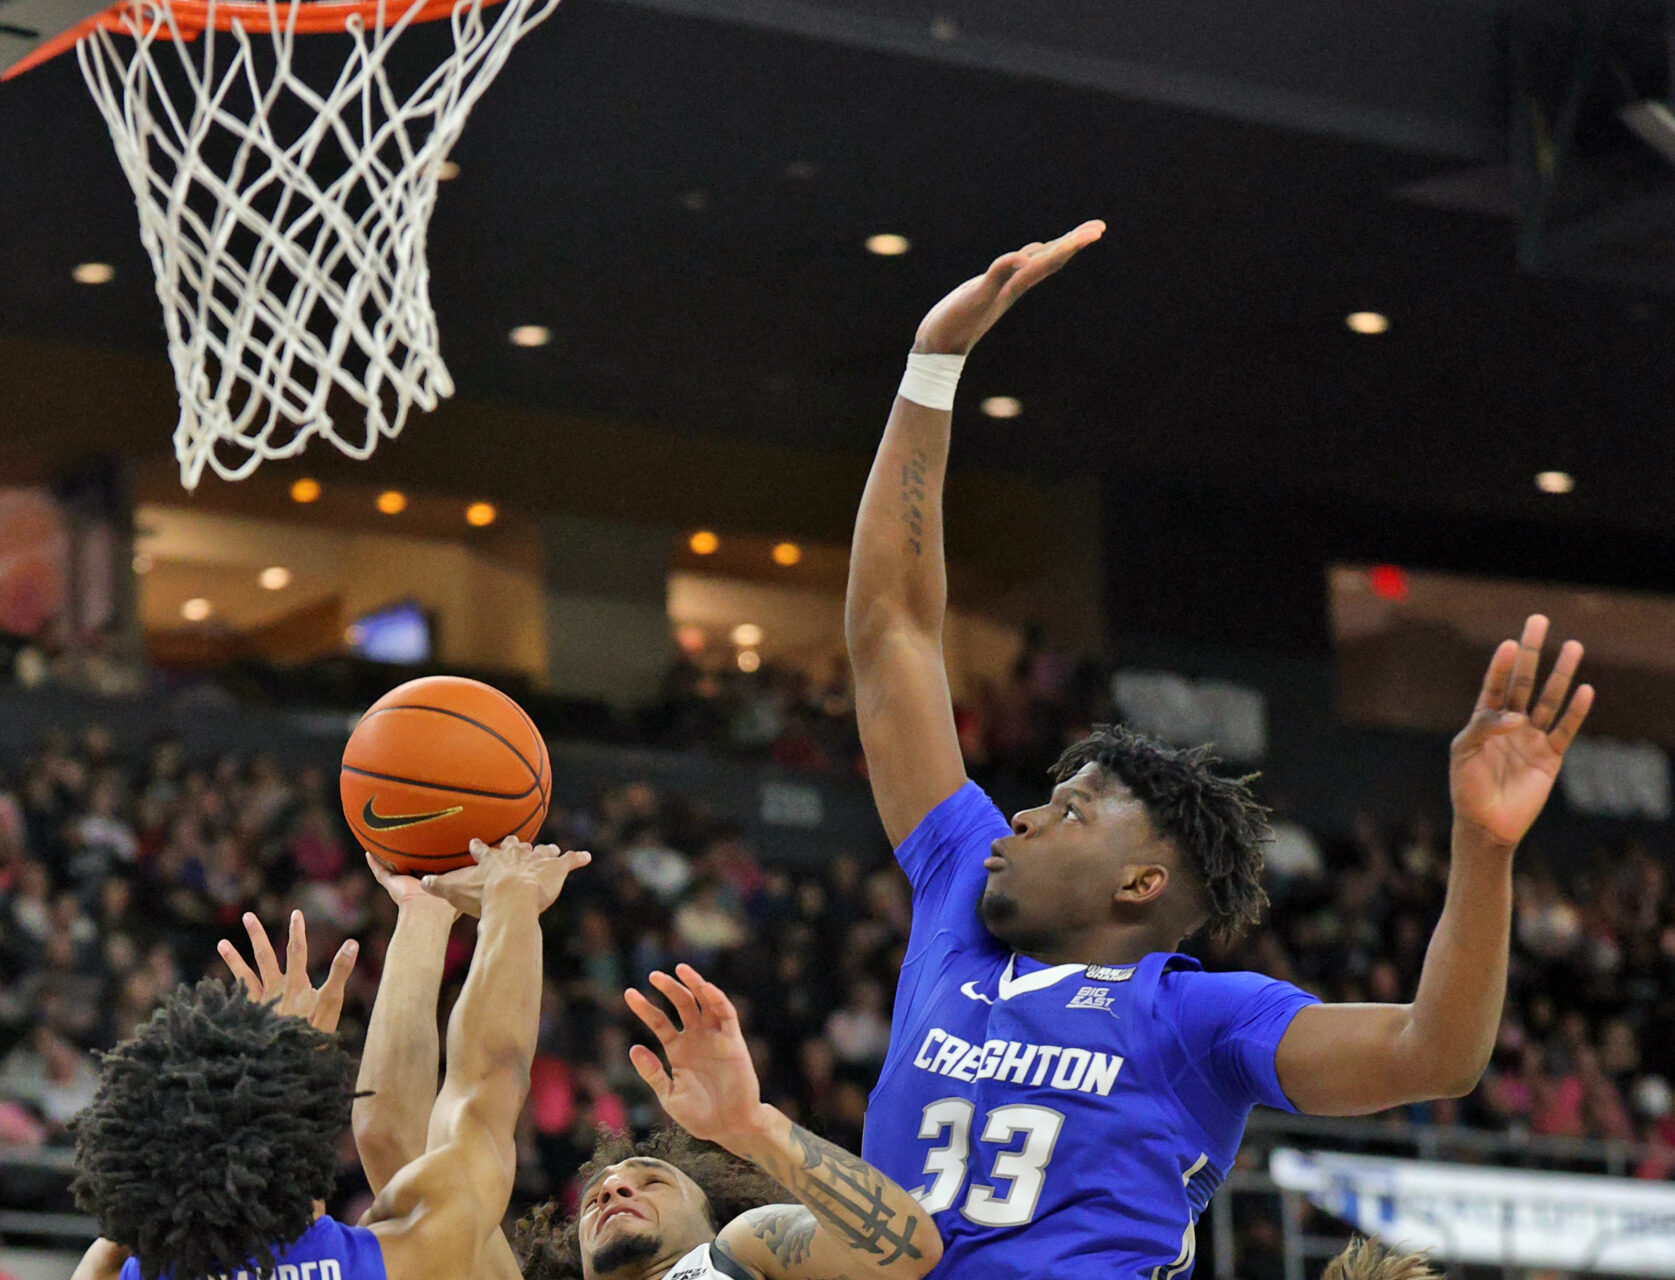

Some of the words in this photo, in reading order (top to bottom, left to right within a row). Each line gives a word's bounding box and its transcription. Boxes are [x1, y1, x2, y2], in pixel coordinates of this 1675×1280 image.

[1077, 986, 1110, 997] BIG
[1069, 995, 1115, 1007] EAST
[908, 1097, 1066, 1227] 33
